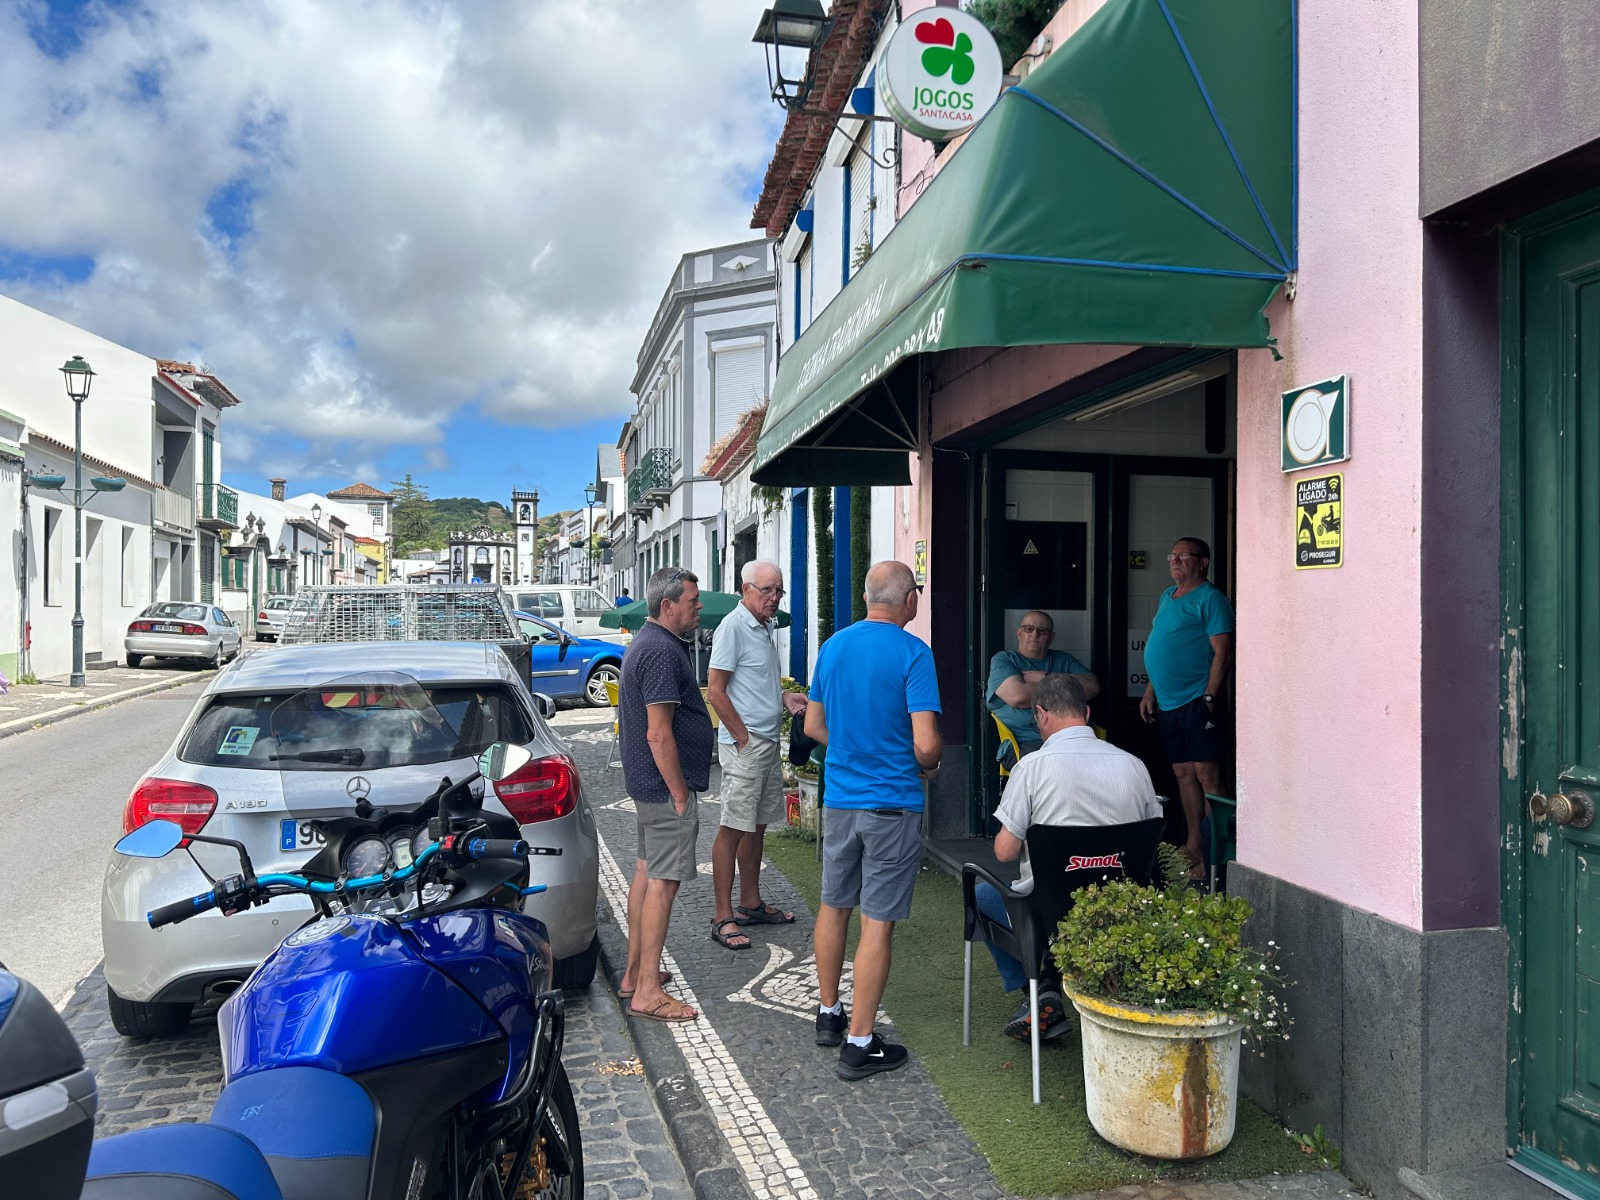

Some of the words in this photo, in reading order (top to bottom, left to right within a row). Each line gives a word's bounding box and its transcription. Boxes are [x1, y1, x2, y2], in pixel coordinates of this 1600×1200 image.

[912, 86, 974, 110] JOGOS
[825, 278, 887, 366] TRADICIONAL
[1299, 480, 1327, 492] ALARME
[1299, 489, 1327, 502] LIGADO
[1309, 550, 1336, 559] PROSEGUR
